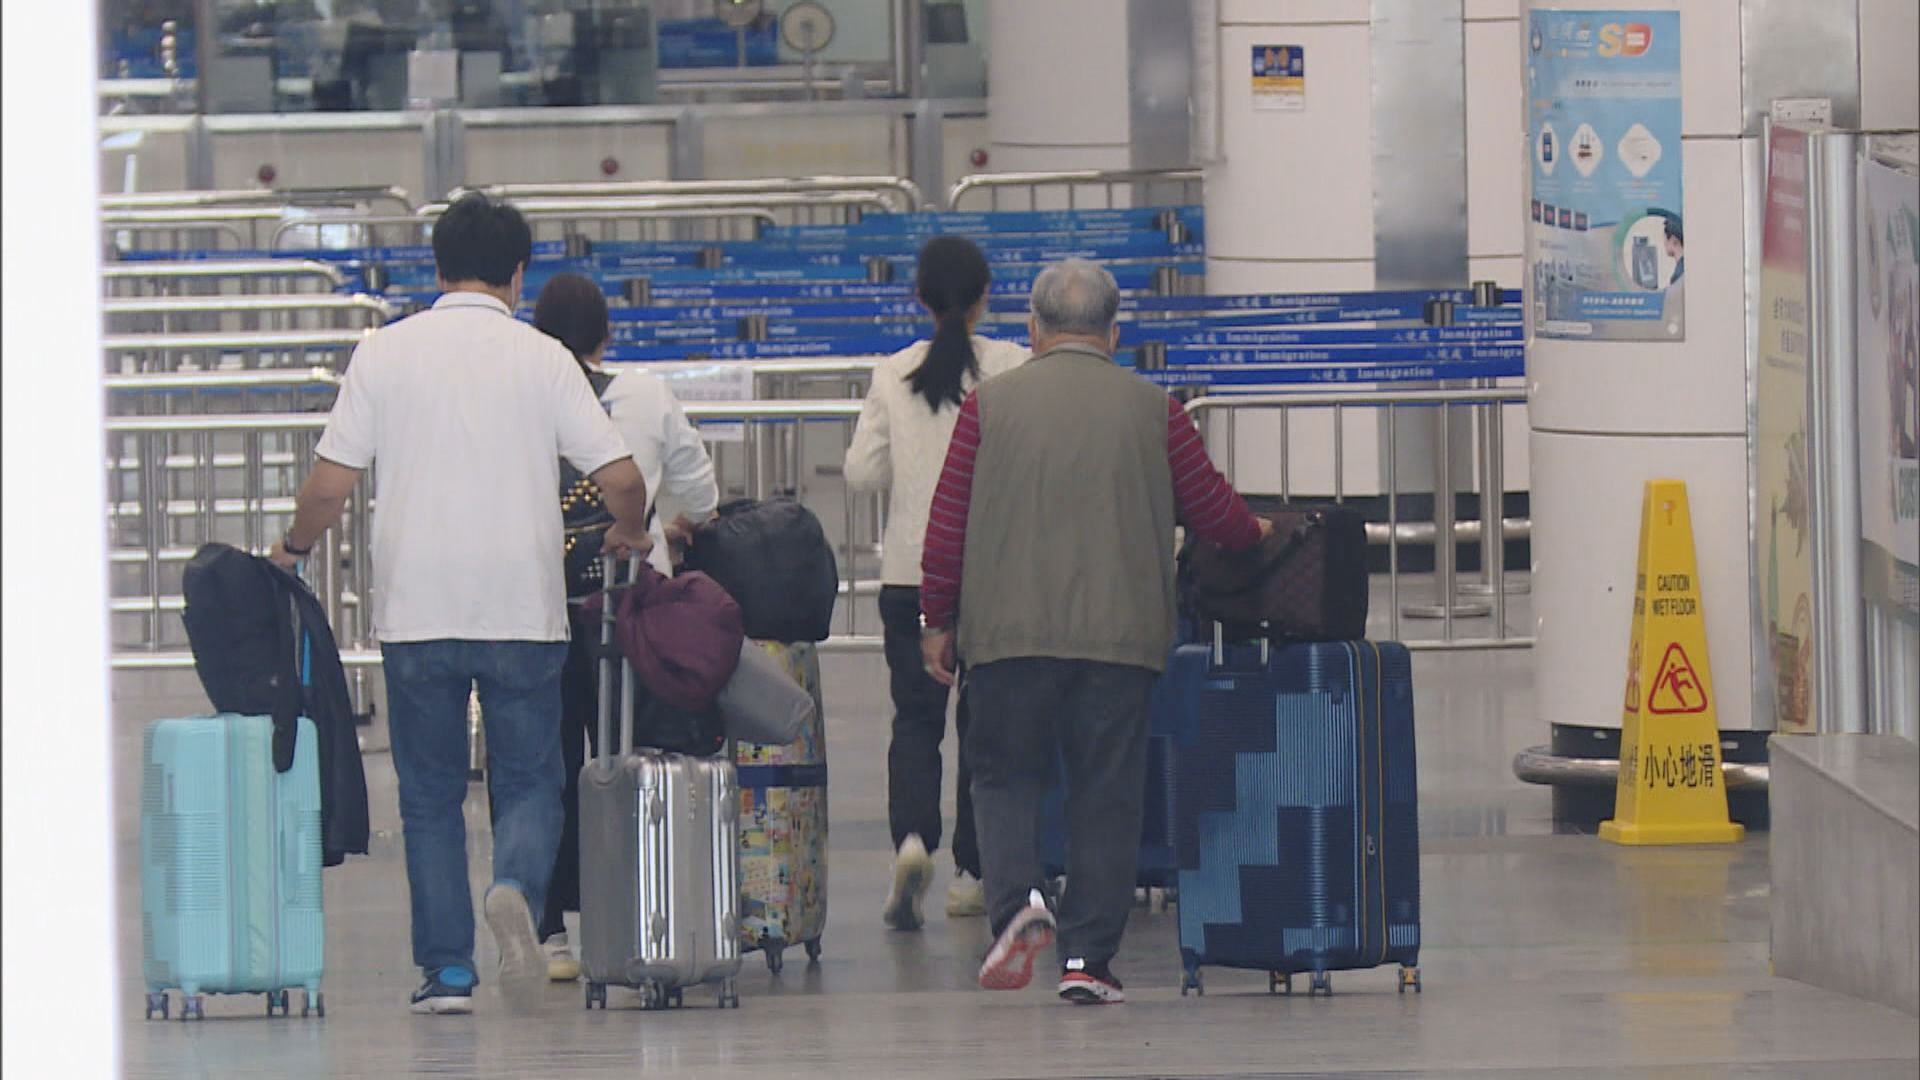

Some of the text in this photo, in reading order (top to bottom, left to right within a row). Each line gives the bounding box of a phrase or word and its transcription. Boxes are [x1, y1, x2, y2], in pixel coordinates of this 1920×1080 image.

[1226, 331, 1300, 343] Immigration
[1439, 328, 1513, 341] Immigration
[1255, 350, 1329, 362] Immigration
[1472, 346, 1523, 359] Immigra
[1141, 372, 1213, 384] mmigration
[1358, 367, 1434, 380] Immigration
[1657, 574, 1690, 592] CAUTION
[1652, 598, 1669, 616] WET
[1671, 598, 1697, 616] FLOOR
[1643, 743, 1715, 790] 小心地滑
